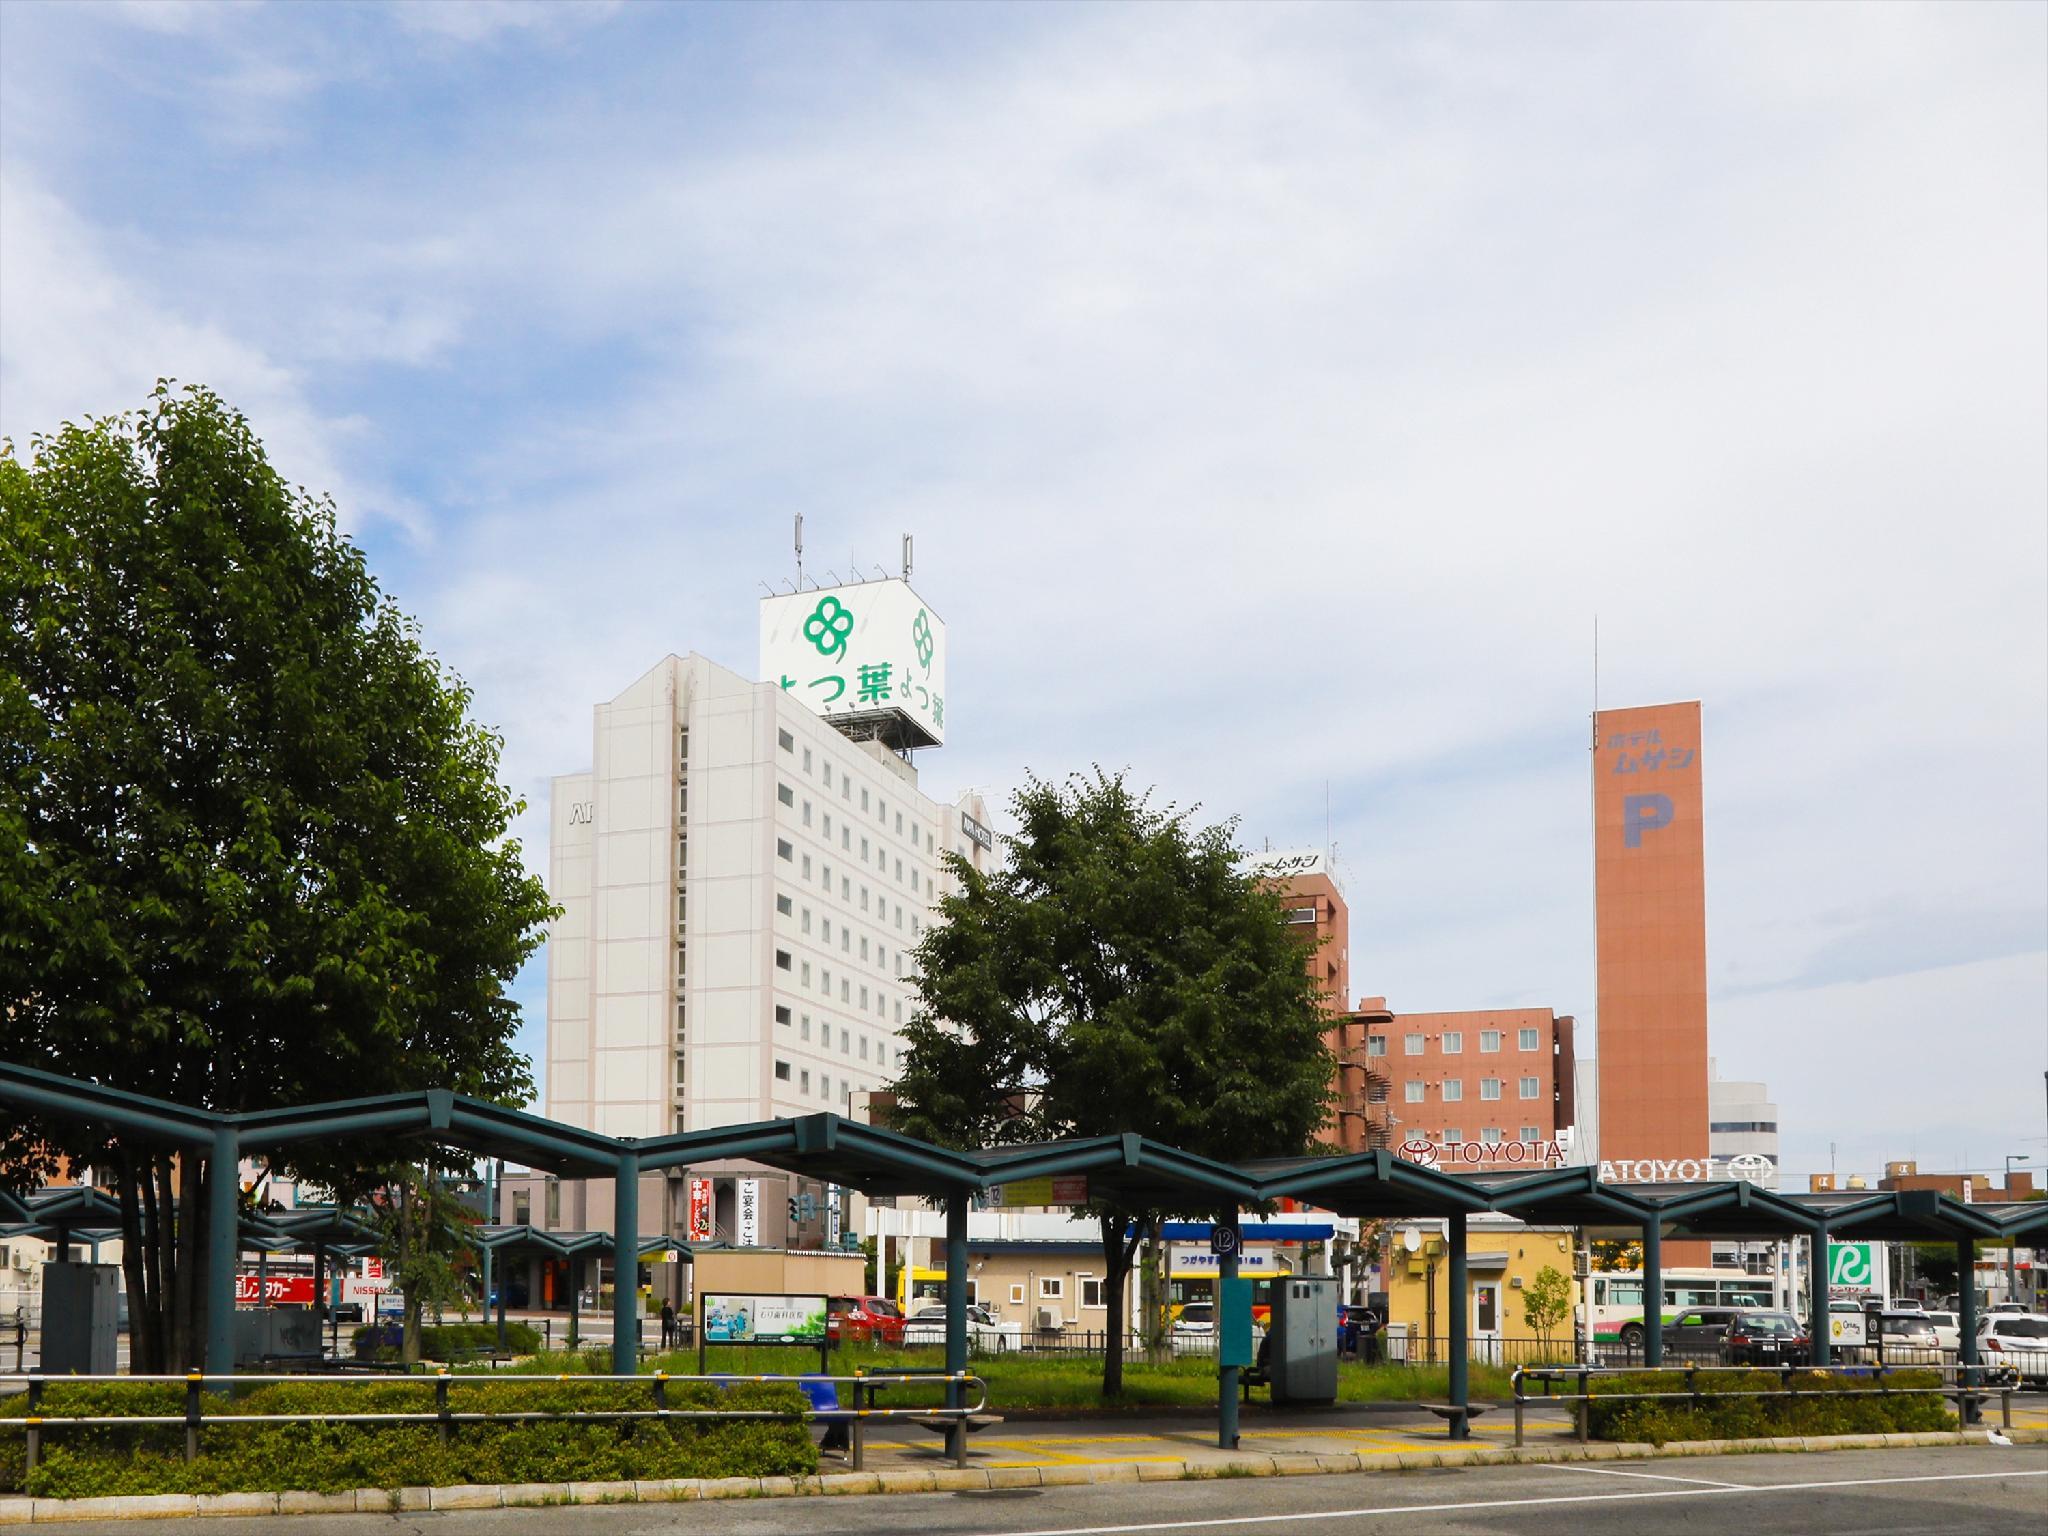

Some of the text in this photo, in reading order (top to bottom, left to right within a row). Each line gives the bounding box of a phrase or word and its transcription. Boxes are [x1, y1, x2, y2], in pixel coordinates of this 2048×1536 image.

[900, 667, 944, 729] よつ葉
[1612, 747, 1696, 774] ムサシ
[1624, 793, 1674, 848] P
[1274, 855, 1319, 869] ムサシ
[1446, 1141, 1564, 1164] TOYOTA
[353, 1286, 386, 1295] NISSAN
